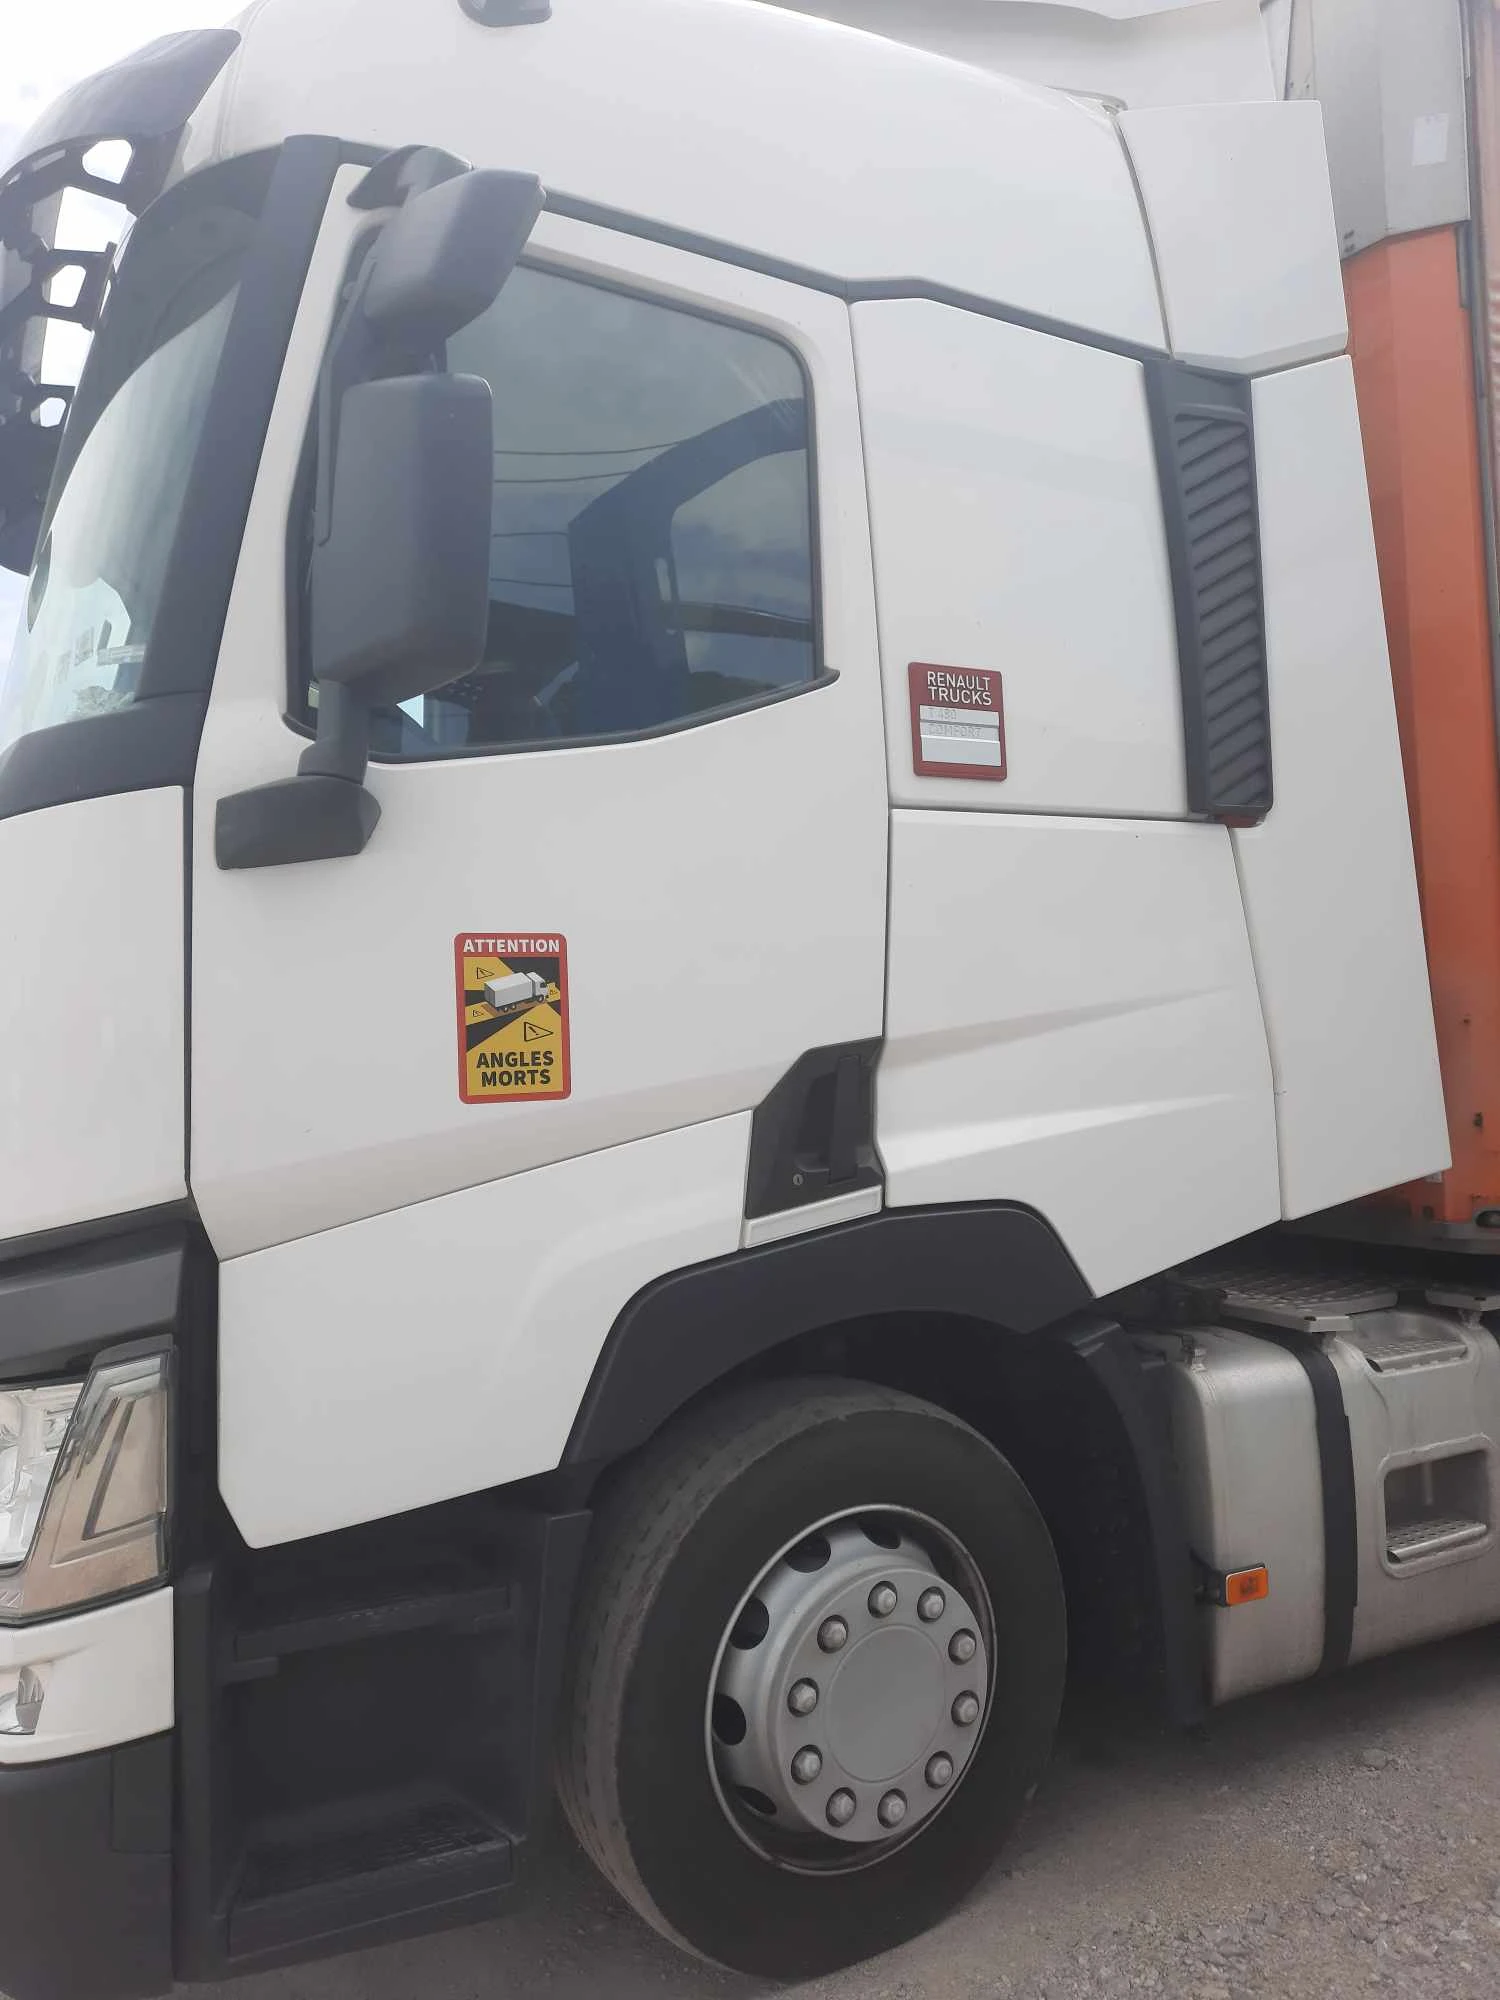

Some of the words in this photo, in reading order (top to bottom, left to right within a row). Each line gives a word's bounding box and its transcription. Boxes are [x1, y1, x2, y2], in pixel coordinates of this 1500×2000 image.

[927, 671, 991, 691] RENAULT
[928, 686, 992, 706] TRUCKS
[463, 939, 560, 953] ATTENTION
[476, 1051, 554, 1068] ANGLES
[481, 1069, 551, 1087] MORTS
